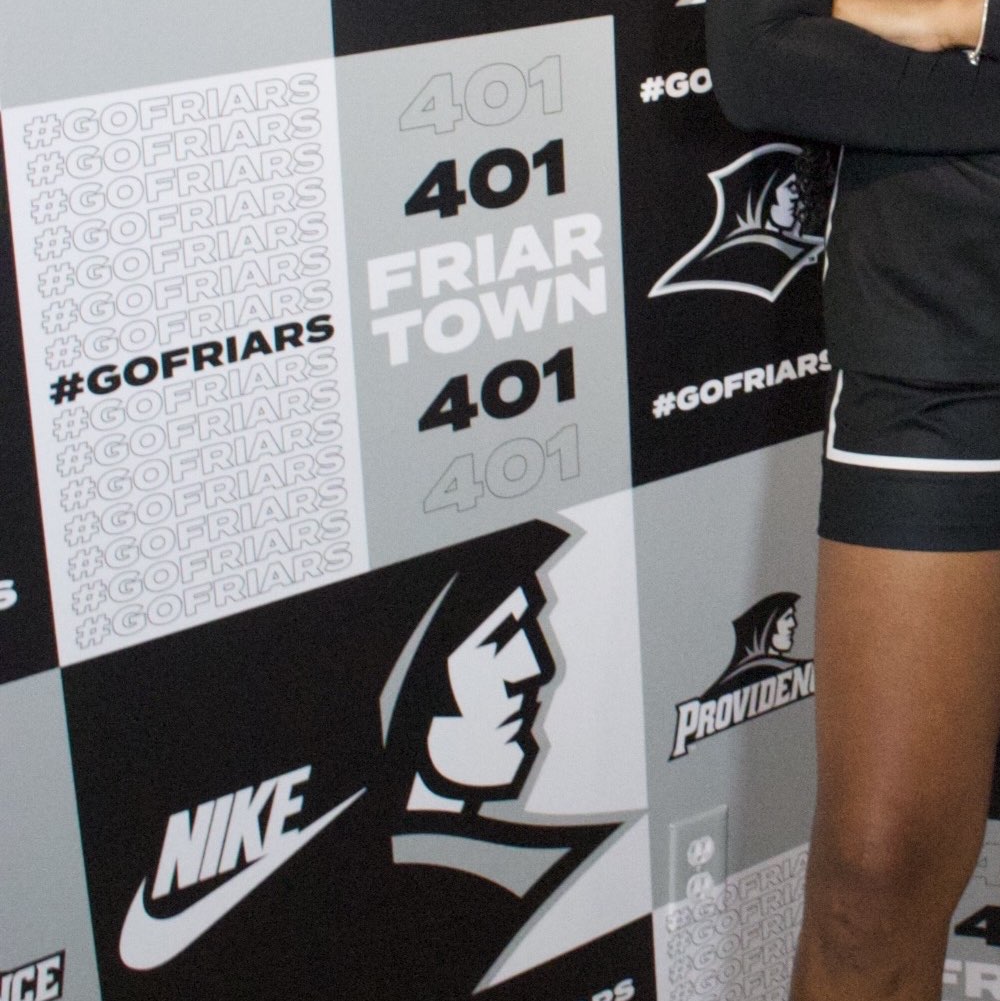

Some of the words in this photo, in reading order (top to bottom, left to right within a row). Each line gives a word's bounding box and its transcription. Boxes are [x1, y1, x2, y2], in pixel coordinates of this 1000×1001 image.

[24, 73, 319, 149] #GOFRIARS
[399, 55, 563, 135] 401
[28, 108, 321, 186] #GOFRIARS
[31, 143, 323, 224] #GOFRIARS
[404, 138, 566, 218] 401
[35, 177, 326, 261] #GOFRIARS
[38, 212, 328, 297] #GOFRIARS
[366, 212, 604, 310] FRIAR
[42, 246, 330, 334] #GOFRIARS
[46, 279, 333, 370] #GOFRIARS
[371, 265, 608, 366] TOWN
[50, 314, 335, 405] #GOFRIARS
[53, 346, 337, 441] #GOFRIARS
[418, 346, 576, 432] 401
[57, 379, 340, 476] #GOFRIARS
[61, 412, 342, 511] #GOFRIARS
[423, 423, 580, 513] 401
[64, 445, 345, 546] #GOFRIARS
[68, 477, 347, 581] #GOFRIARS
[72, 510, 350, 615] #GOFRIARS
[76, 542, 352, 649] #GOFRIARS
[152, 765, 313, 899] NIKE
